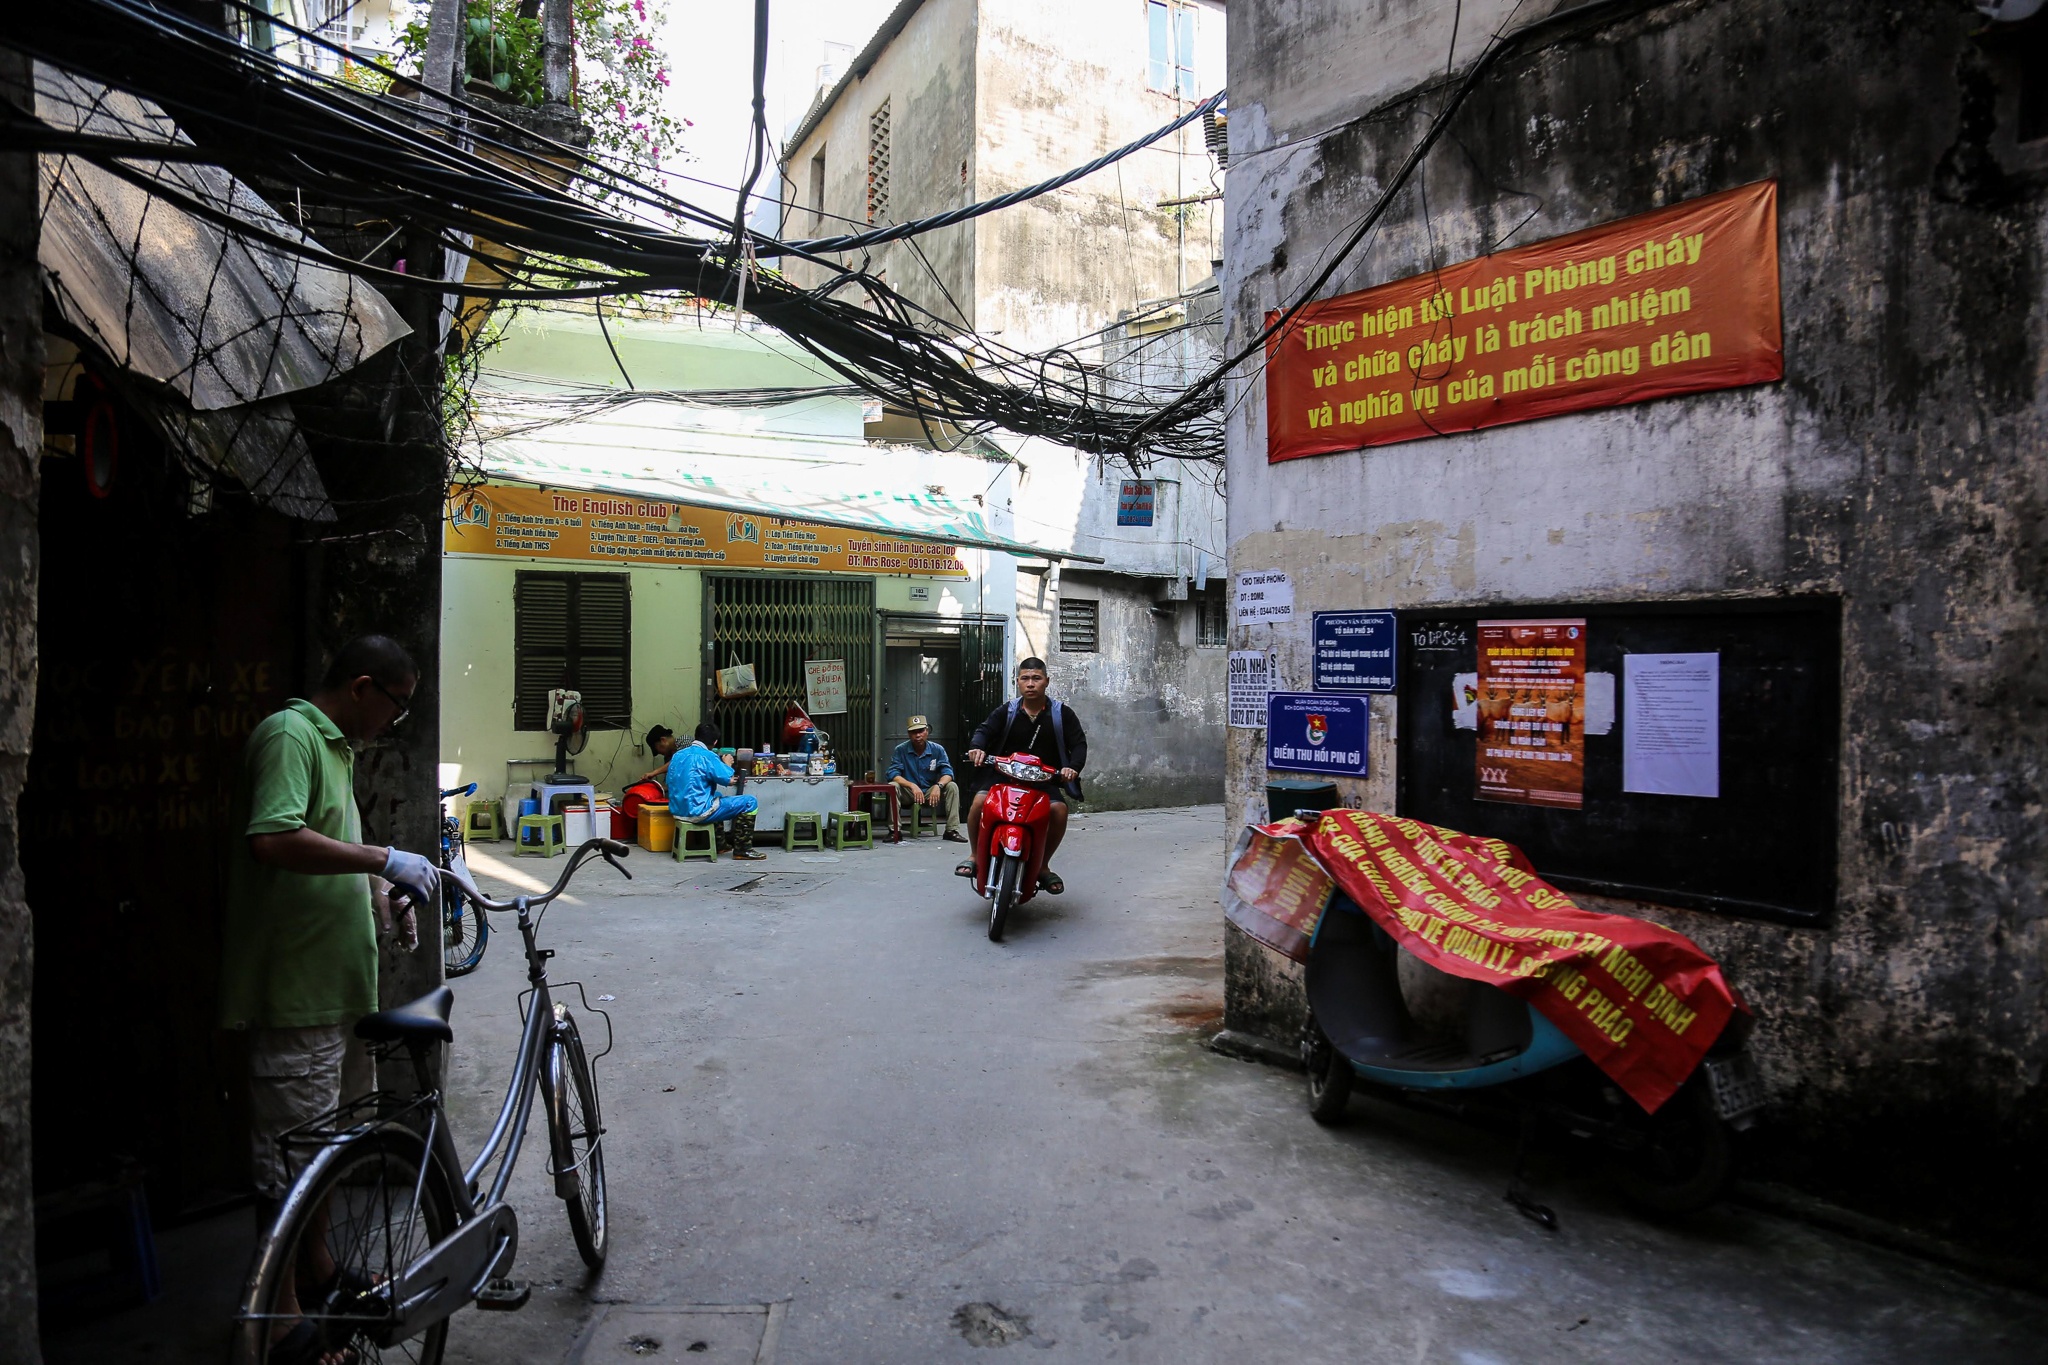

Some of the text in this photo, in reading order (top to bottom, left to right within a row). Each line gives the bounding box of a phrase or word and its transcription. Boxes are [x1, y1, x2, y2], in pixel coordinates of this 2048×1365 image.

[1303, 232, 1704, 351] Thực hiện tốt Luật Phòng cháy
[1313, 286, 1692, 389] và chữa cháy là trách nhiệm
[1308, 328, 1711, 429] và nghĩa vụ của mỗi công dân
[553, 496, 667, 518] The English club
[522, 516, 534, 524] Anh
[615, 521, 626, 529] Anh
[522, 528, 533, 536] Anh
[547, 530, 559, 539] học
[642, 535, 659, 543] TOEFL
[694, 538, 705, 546] Anh
[521, 541, 533, 549] Anh
[534, 542, 550, 550] THCS
[848, 538, 872, 552] Tuyển
[874, 541, 891, 553] sinh
[893, 541, 909, 553] liên
[911, 543, 924, 556] tục
[848, 555, 860, 566] ĐT:
[862, 555, 879, 566] Mrs
[880, 556, 901, 568] Rose
[1242, 576, 1253, 586] CHO
[1230, 652, 1247, 674] SỬA
[1249, 655, 1268, 674] NHÀ
[1231, 709, 1267, 726] 0972 877 432
[1273, 743, 1295, 760] ĐIỂM
[1296, 748, 1313, 762] THU
[1330, 750, 1346, 764] PIN
[1347, 750, 1360, 765] CŨ
[1600, 944, 1654, 1002] NGHỊ
[1642, 982, 1698, 1036] ĐỊNH
[1580, 990, 1635, 1048] PHÁO.
